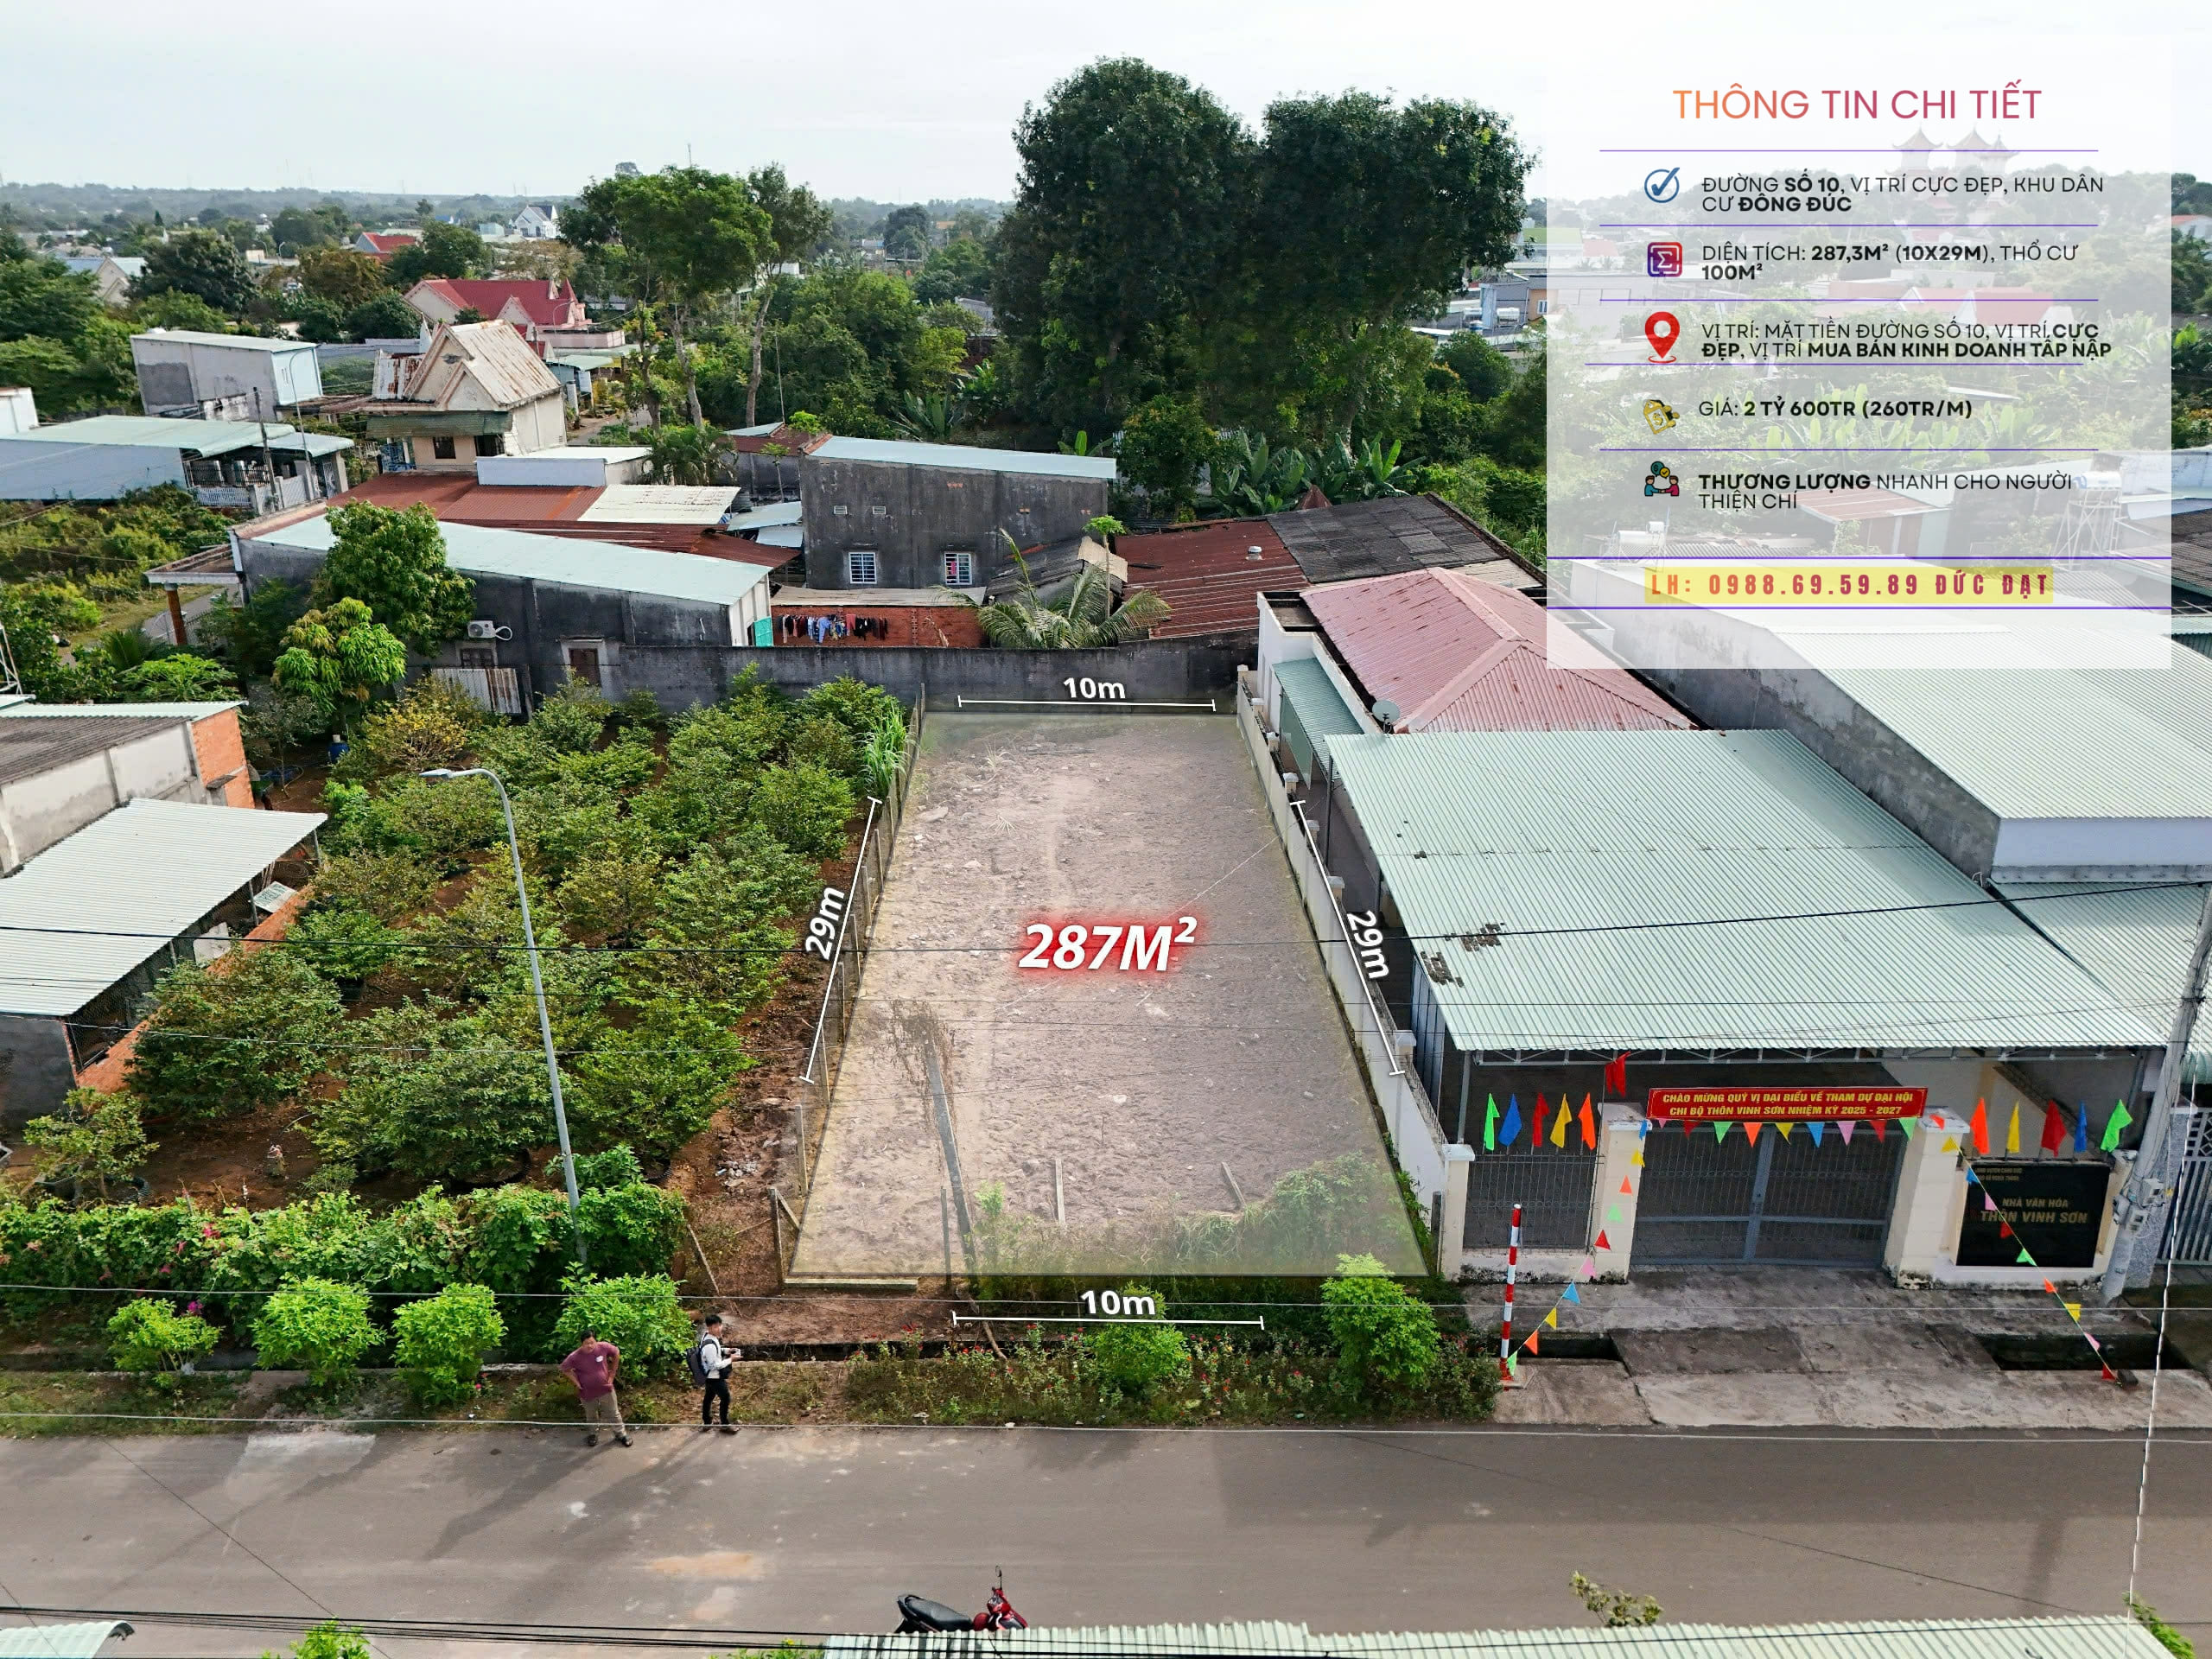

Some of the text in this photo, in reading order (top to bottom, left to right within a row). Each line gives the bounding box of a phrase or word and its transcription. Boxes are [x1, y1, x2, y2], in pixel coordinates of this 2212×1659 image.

[1662, 1093, 1690, 1103] CHÀO
[1763, 1094, 1780, 1103] ĐẠI
[1826, 1093, 1855, 1102] THAM
[1875, 1093, 1892, 1103] ĐẠI
[1895, 1092, 1913, 1103] HỘI
[1669, 1107, 1687, 1116] CHI
[1707, 1106, 1734, 1116] THÔN
[1737, 1106, 1761, 1115] VINH
[1764, 1106, 1785, 1115] SƠN
[1788, 1105, 1822, 1116] NHIỆM
[1840, 1106, 1866, 1115] 2025
[1876, 1106, 1902, 1115] 2027
[1980, 1209, 2088, 1224] THÔN VINH SƠN
